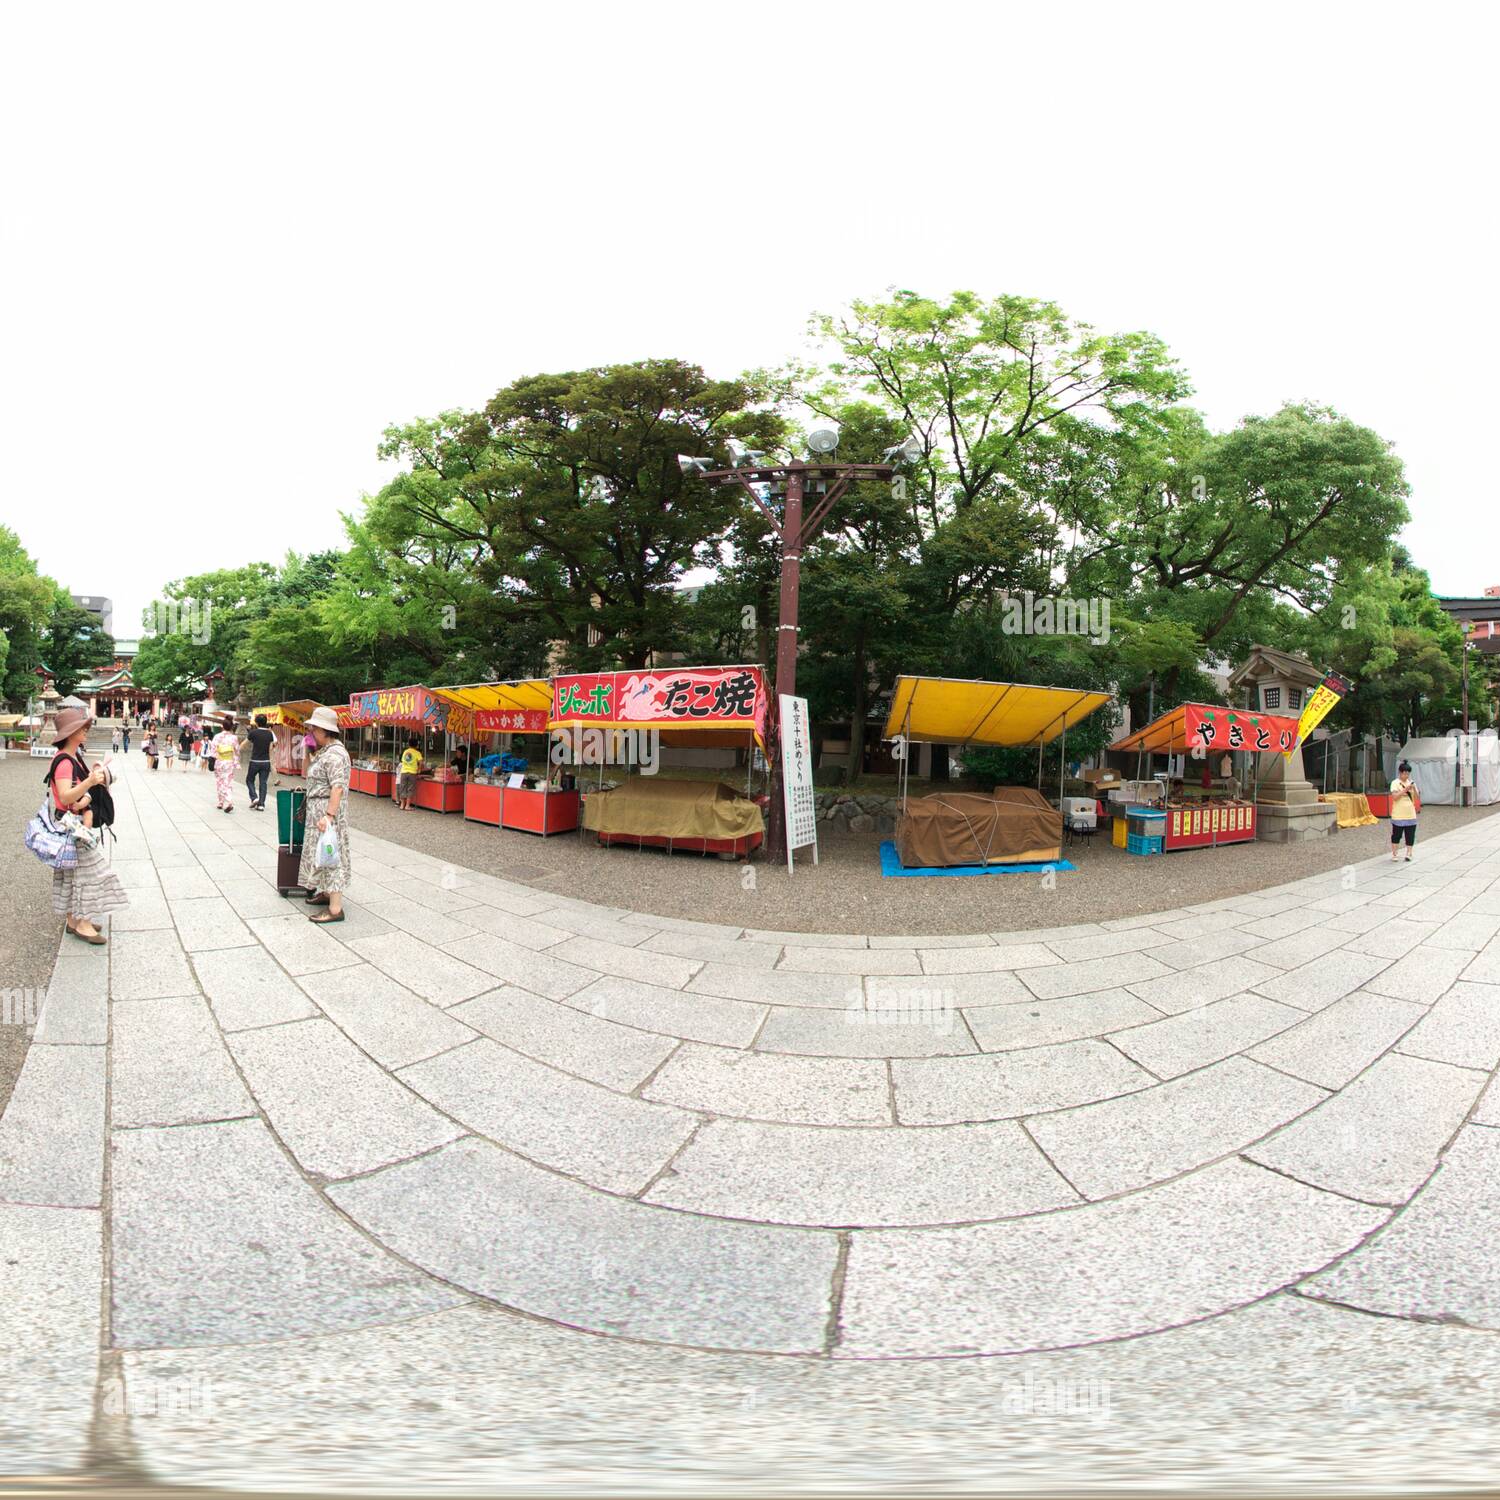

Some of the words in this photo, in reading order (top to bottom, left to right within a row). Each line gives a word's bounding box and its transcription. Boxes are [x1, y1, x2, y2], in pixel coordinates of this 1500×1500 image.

[558, 683, 614, 717] ジャンボ
[664, 671, 757, 717] たこ焼
[489, 713, 526, 729] いか焼
[1196, 722, 1292, 750] やきとり
[792, 700, 804, 784] 東京十社めぐり
